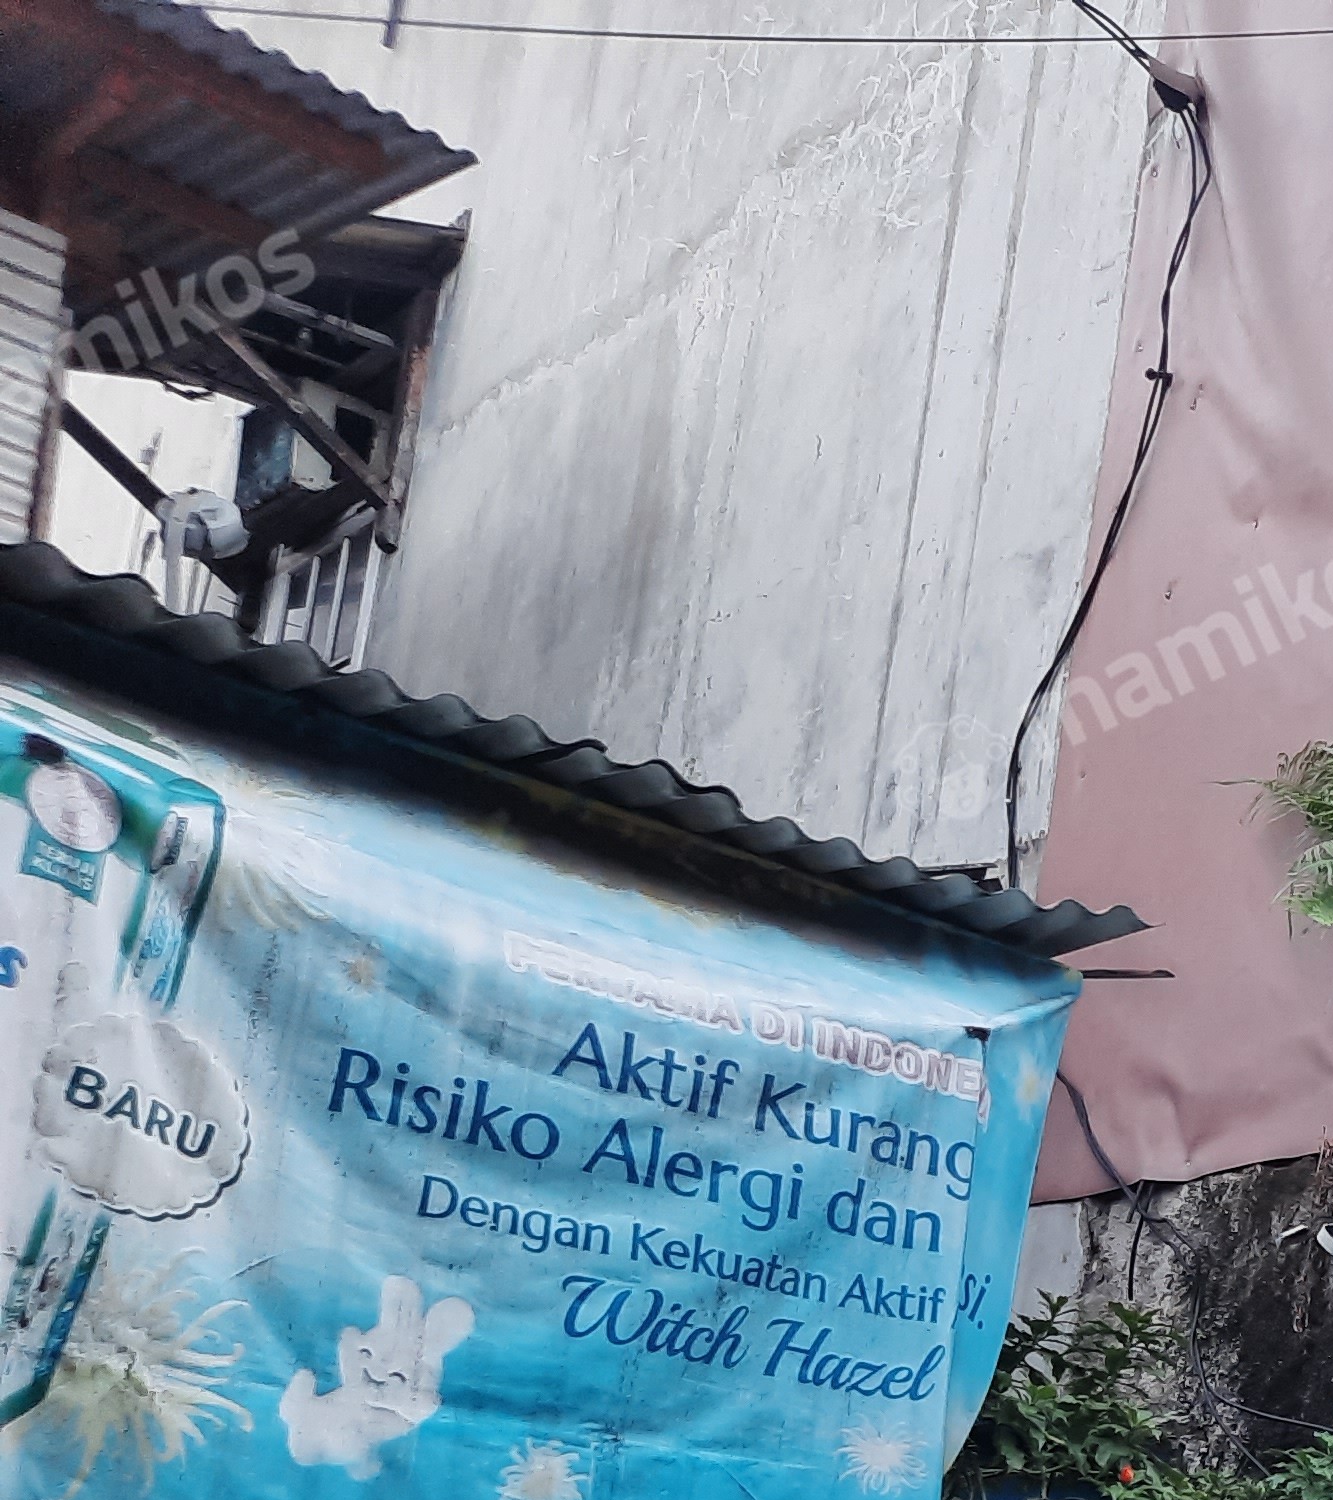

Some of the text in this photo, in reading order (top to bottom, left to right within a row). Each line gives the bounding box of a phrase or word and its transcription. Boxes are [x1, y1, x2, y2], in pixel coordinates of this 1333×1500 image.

[65, 1065, 216, 1158] BARU
[327, 1046, 942, 1254] Risiko Alergi dan
[552, 1022, 976, 1201] Aktif Kurang
[417, 1174, 947, 1324] Dengan Kekuatan Aktif
[561, 1275, 947, 1403] Witch Hazel
